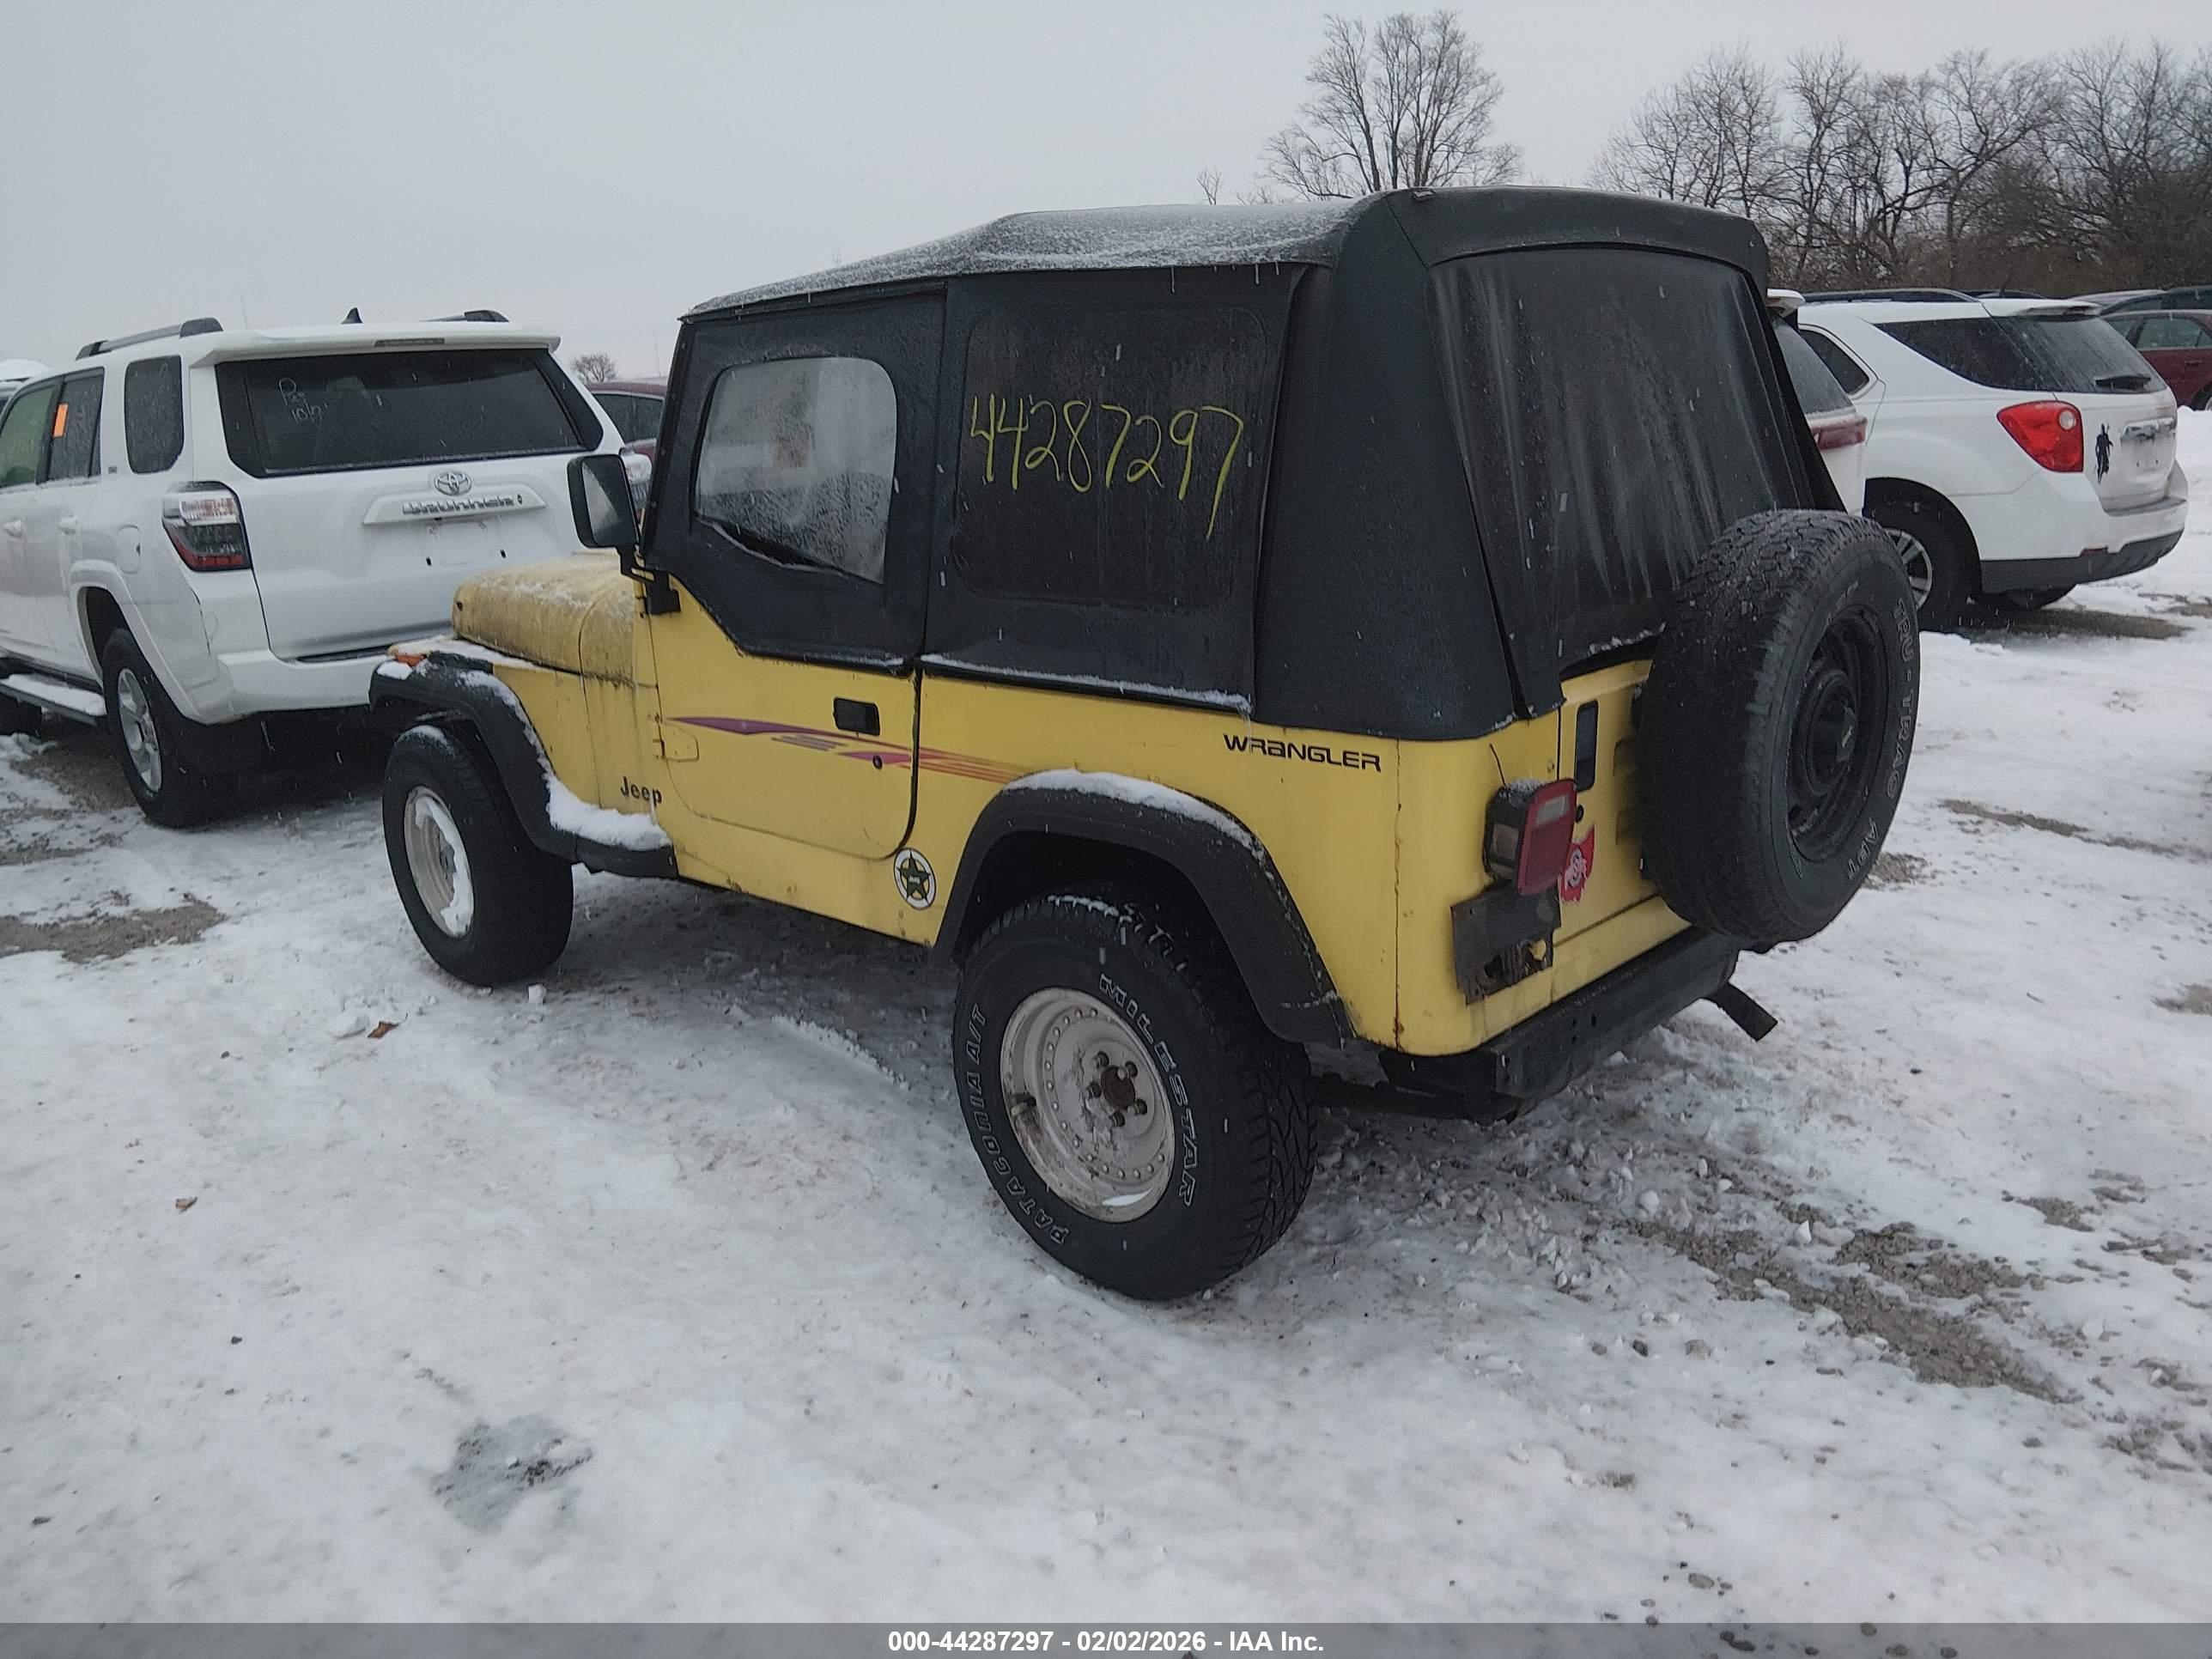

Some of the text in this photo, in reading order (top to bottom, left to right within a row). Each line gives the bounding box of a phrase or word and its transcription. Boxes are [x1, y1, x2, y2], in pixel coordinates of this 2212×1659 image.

[970, 392, 1244, 541] 44287297
[1893, 598, 1915, 663] TRU
[621, 775, 662, 807] Jeep
[1887, 689, 1914, 799] TRAC
[966, 1002, 1071, 1245] PATAGONIA A/T
[1098, 972, 1199, 1207] MILESTAR
